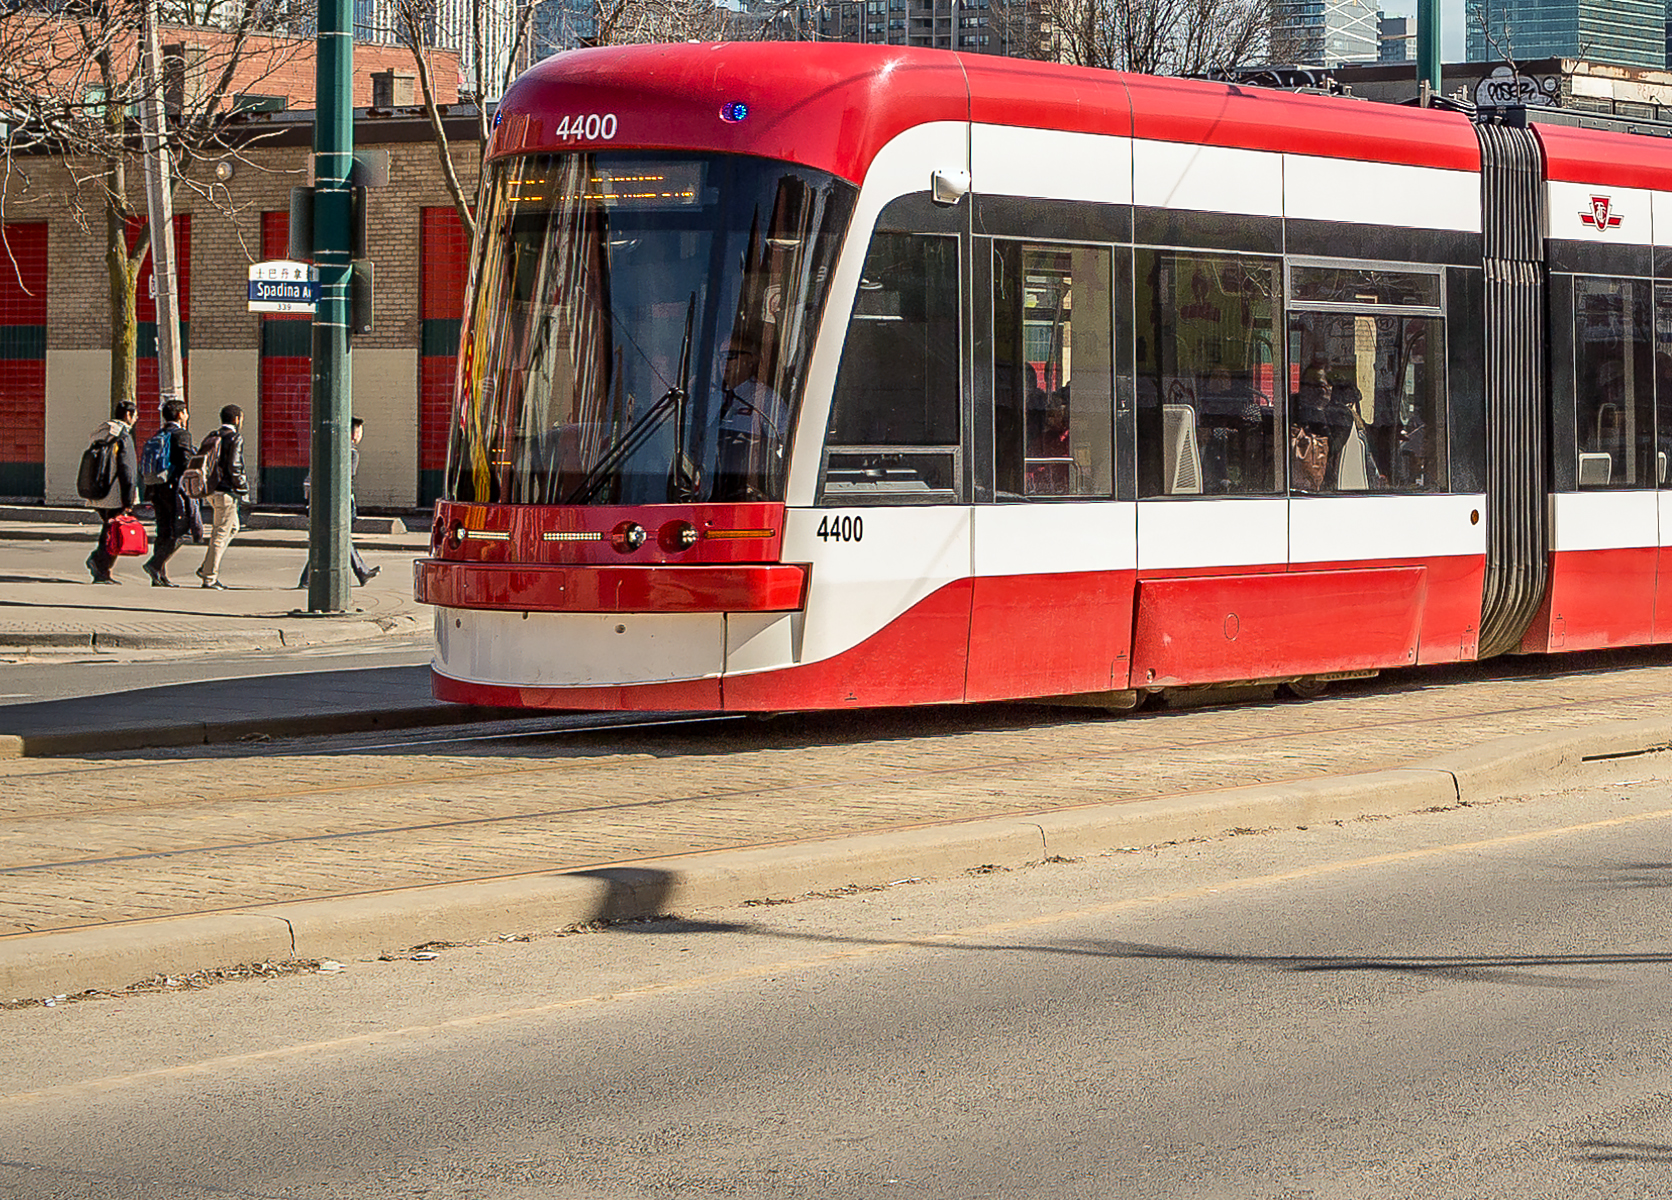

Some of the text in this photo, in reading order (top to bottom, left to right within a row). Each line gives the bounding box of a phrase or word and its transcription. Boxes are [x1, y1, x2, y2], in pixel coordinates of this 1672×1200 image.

[556, 113, 618, 141] 4400
[257, 281, 301, 300] Spadina
[816, 515, 864, 543] 4400
